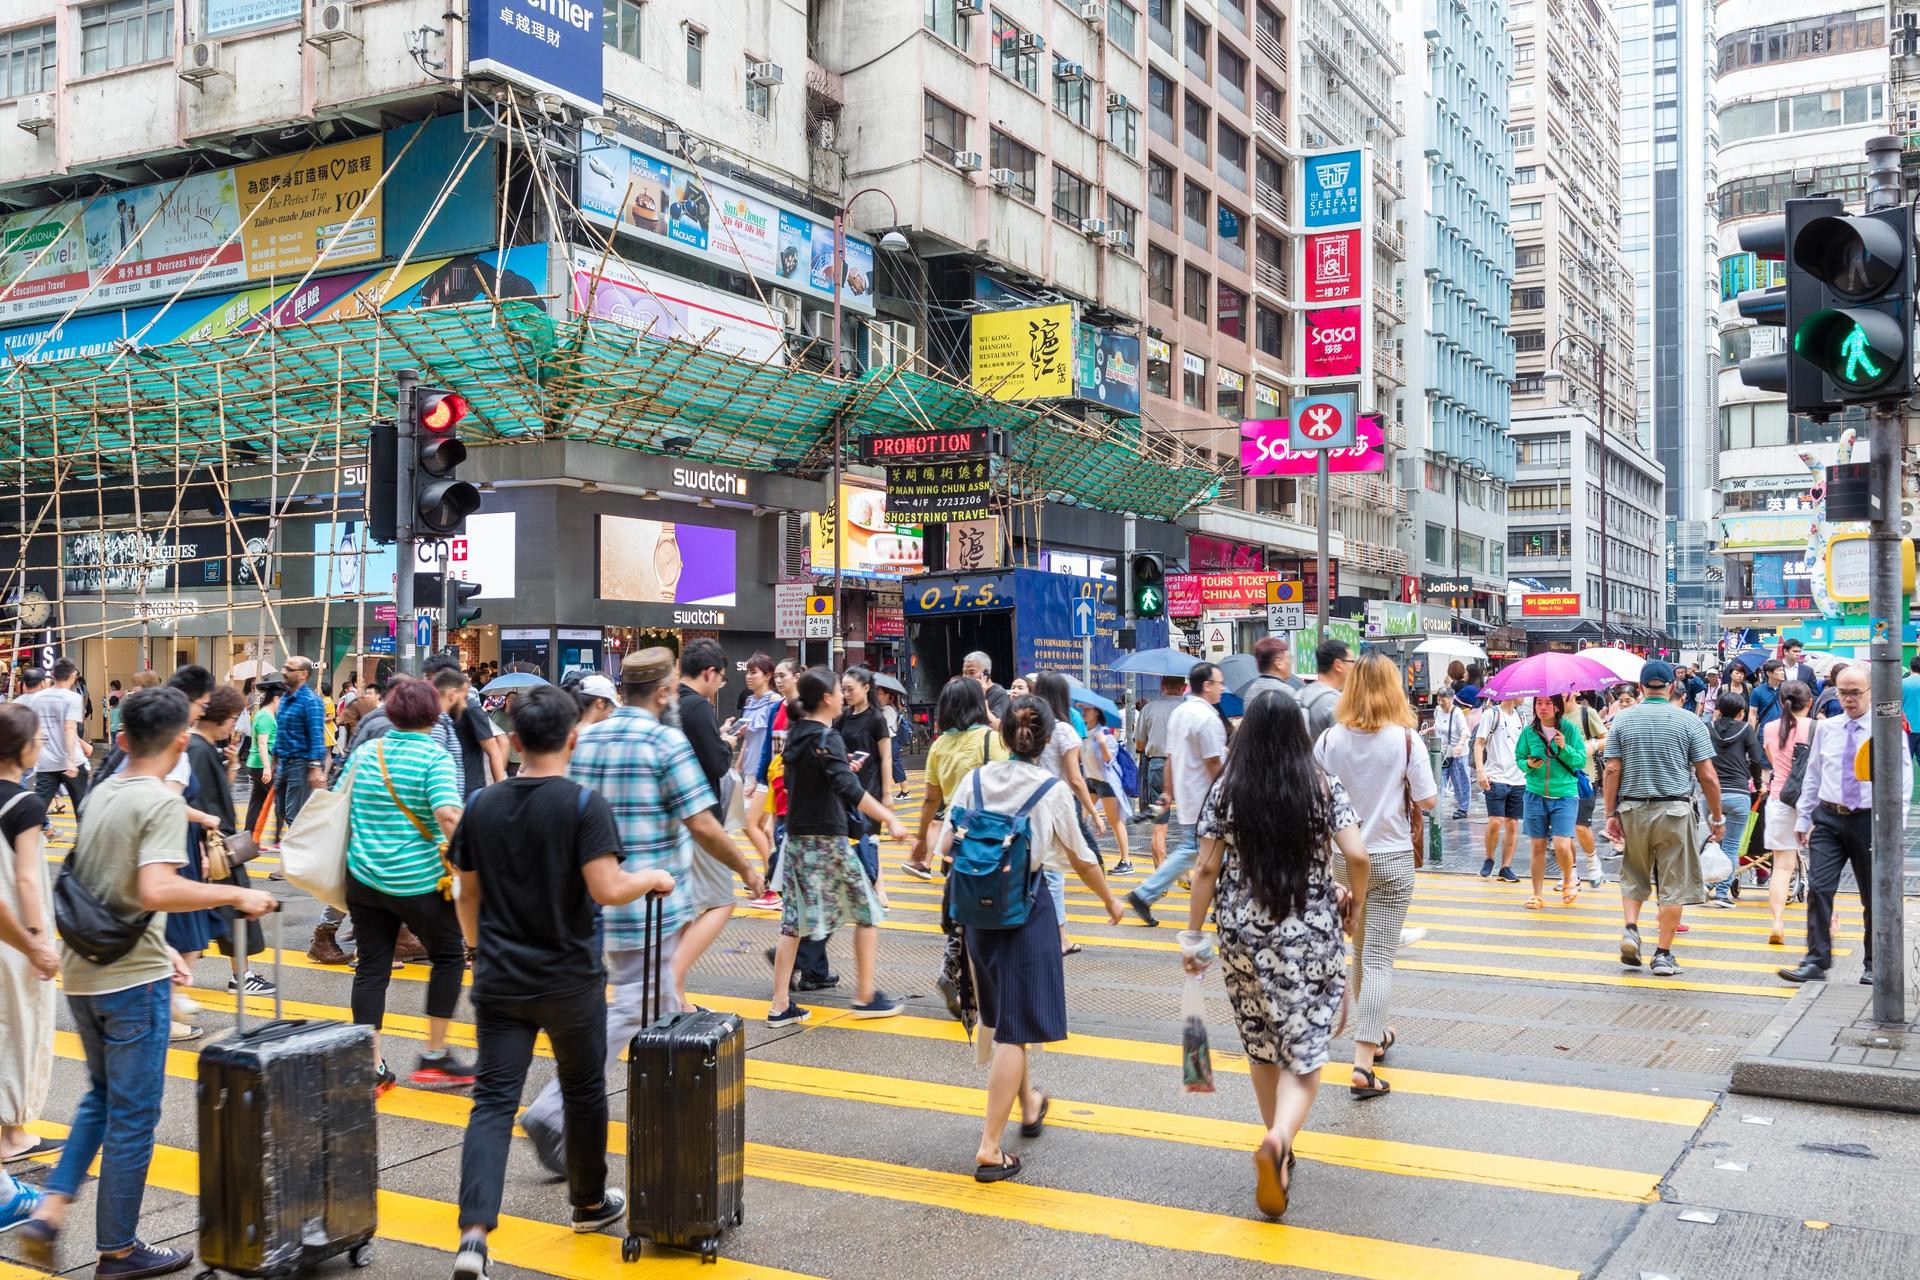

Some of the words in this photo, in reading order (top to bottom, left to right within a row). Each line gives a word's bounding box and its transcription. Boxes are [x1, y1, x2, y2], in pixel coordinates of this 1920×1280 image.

[527, 0, 593, 32] mier
[500, 7, 560, 48] 卓越理財
[348, 155, 371, 175] 旅程
[632, 154, 649, 169] HOTEL
[632, 166, 660, 182] BOOKING
[267, 197, 281, 210] The
[283, 193, 308, 207] Perfect
[311, 188, 327, 202] Trip
[583, 198, 612, 214] TICKETING
[1310, 197, 1357, 210] SEEFAH
[254, 211, 298, 228] Tailor-made
[300, 208, 315, 220] Just
[317, 206, 331, 217] For
[780, 213, 788, 222] ALL
[672, 227, 697, 244] PACKAGE
[157, 257, 187, 272] Overseas
[189, 252, 218, 267] Weddng
[167, 267, 238, 286] wedding@sunflower.com
[13, 282, 46, 297] Educational
[48, 280, 66, 291] Travel
[115, 284, 128, 295] 2722
[129, 282, 141, 293] 9233
[1315, 287, 1333, 298] 二樓
[1334, 286, 1350, 296] 2/F
[51, 328, 64, 342] TO
[979, 335, 990, 343] WU
[42, 350, 55, 361] OF
[57, 347, 77, 360] THE
[979, 342, 1012, 352] SHANGHAI
[1324, 344, 1343, 354] 莎莎
[979, 351, 1019, 360] RESTAURANT
[873, 433, 971, 456] PROMOTION
[673, 467, 737, 494] swatch
[886, 486, 895, 495] IP
[896, 485, 914, 495] MAN
[916, 485, 939, 494] WING
[942, 483, 966, 494] CHUN
[968, 481, 990, 492] ASSN
[912, 498, 929, 507] 4/F
[936, 495, 981, 507] 27232306
[884, 511, 948, 523] SHOESTRING
[952, 508, 990, 521] TRAVEL
[134, 544, 197, 559] ONGINES
[1165, 583, 1181, 591] vel
[1201, 576, 1233, 587] TOURS
[1237, 575, 1276, 586] TICKETS
[920, 584, 999, 610] O.T.S.
[1202, 589, 1242, 600] CHINA
[1245, 589, 1266, 599] VIS
[1286, 605, 1300, 614] hrs
[674, 609, 718, 625] swatch
[809, 617, 818, 625] 24
[819, 617, 830, 625] hrs
[1274, 616, 1297, 627] 全日
[1423, 616, 1452, 632] GIORDANO
[811, 626, 828, 636] 全日
